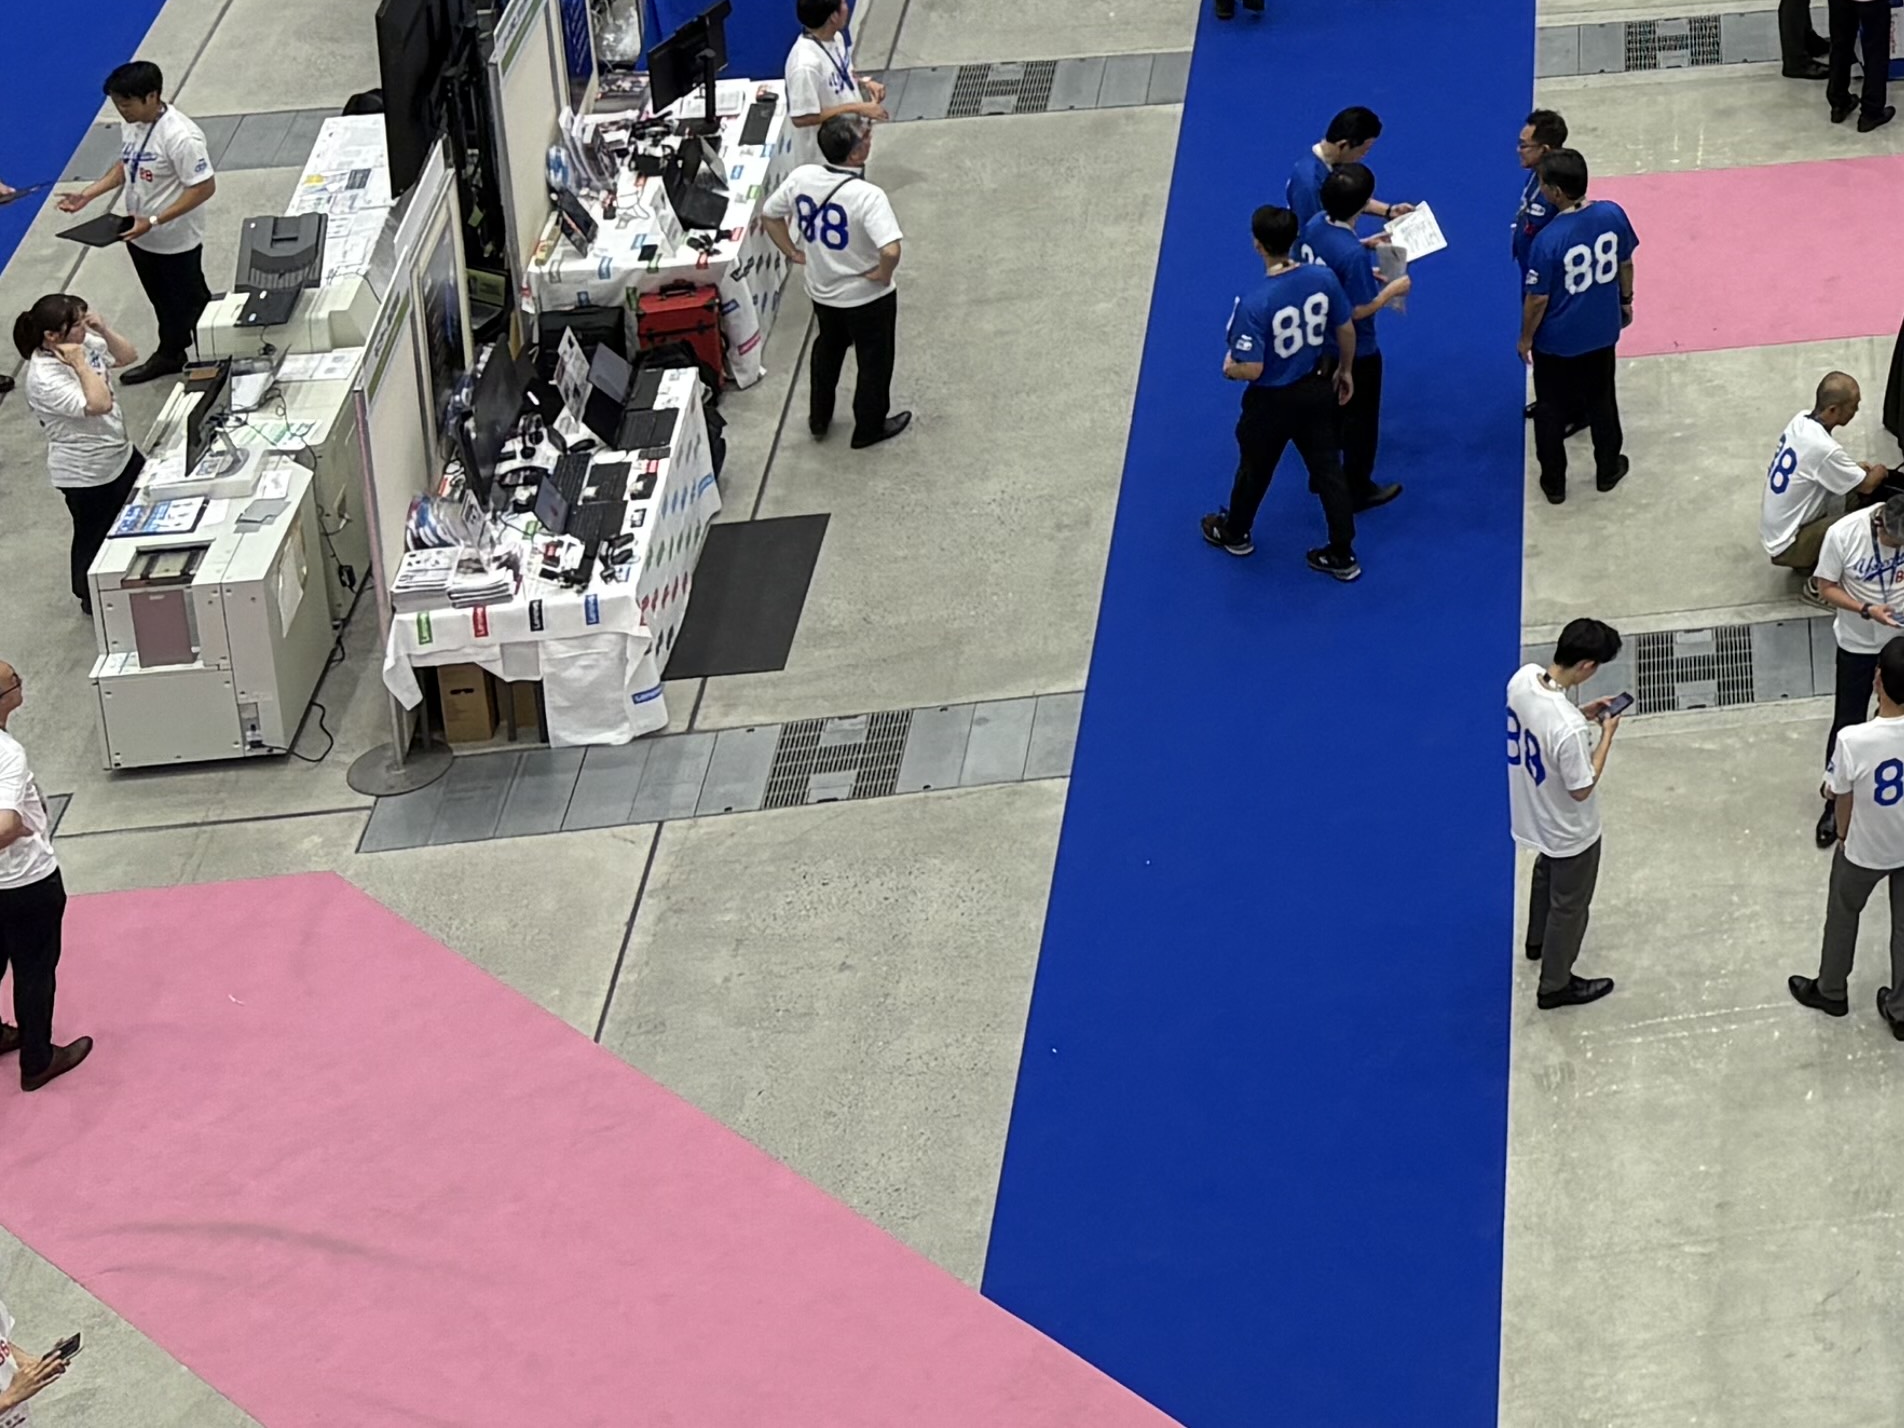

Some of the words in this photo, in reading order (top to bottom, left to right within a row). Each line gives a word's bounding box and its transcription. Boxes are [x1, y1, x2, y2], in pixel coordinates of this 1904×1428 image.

[796, 192, 849, 251] 88
[1563, 231, 1620, 295] 88
[1272, 291, 1331, 360] 88
